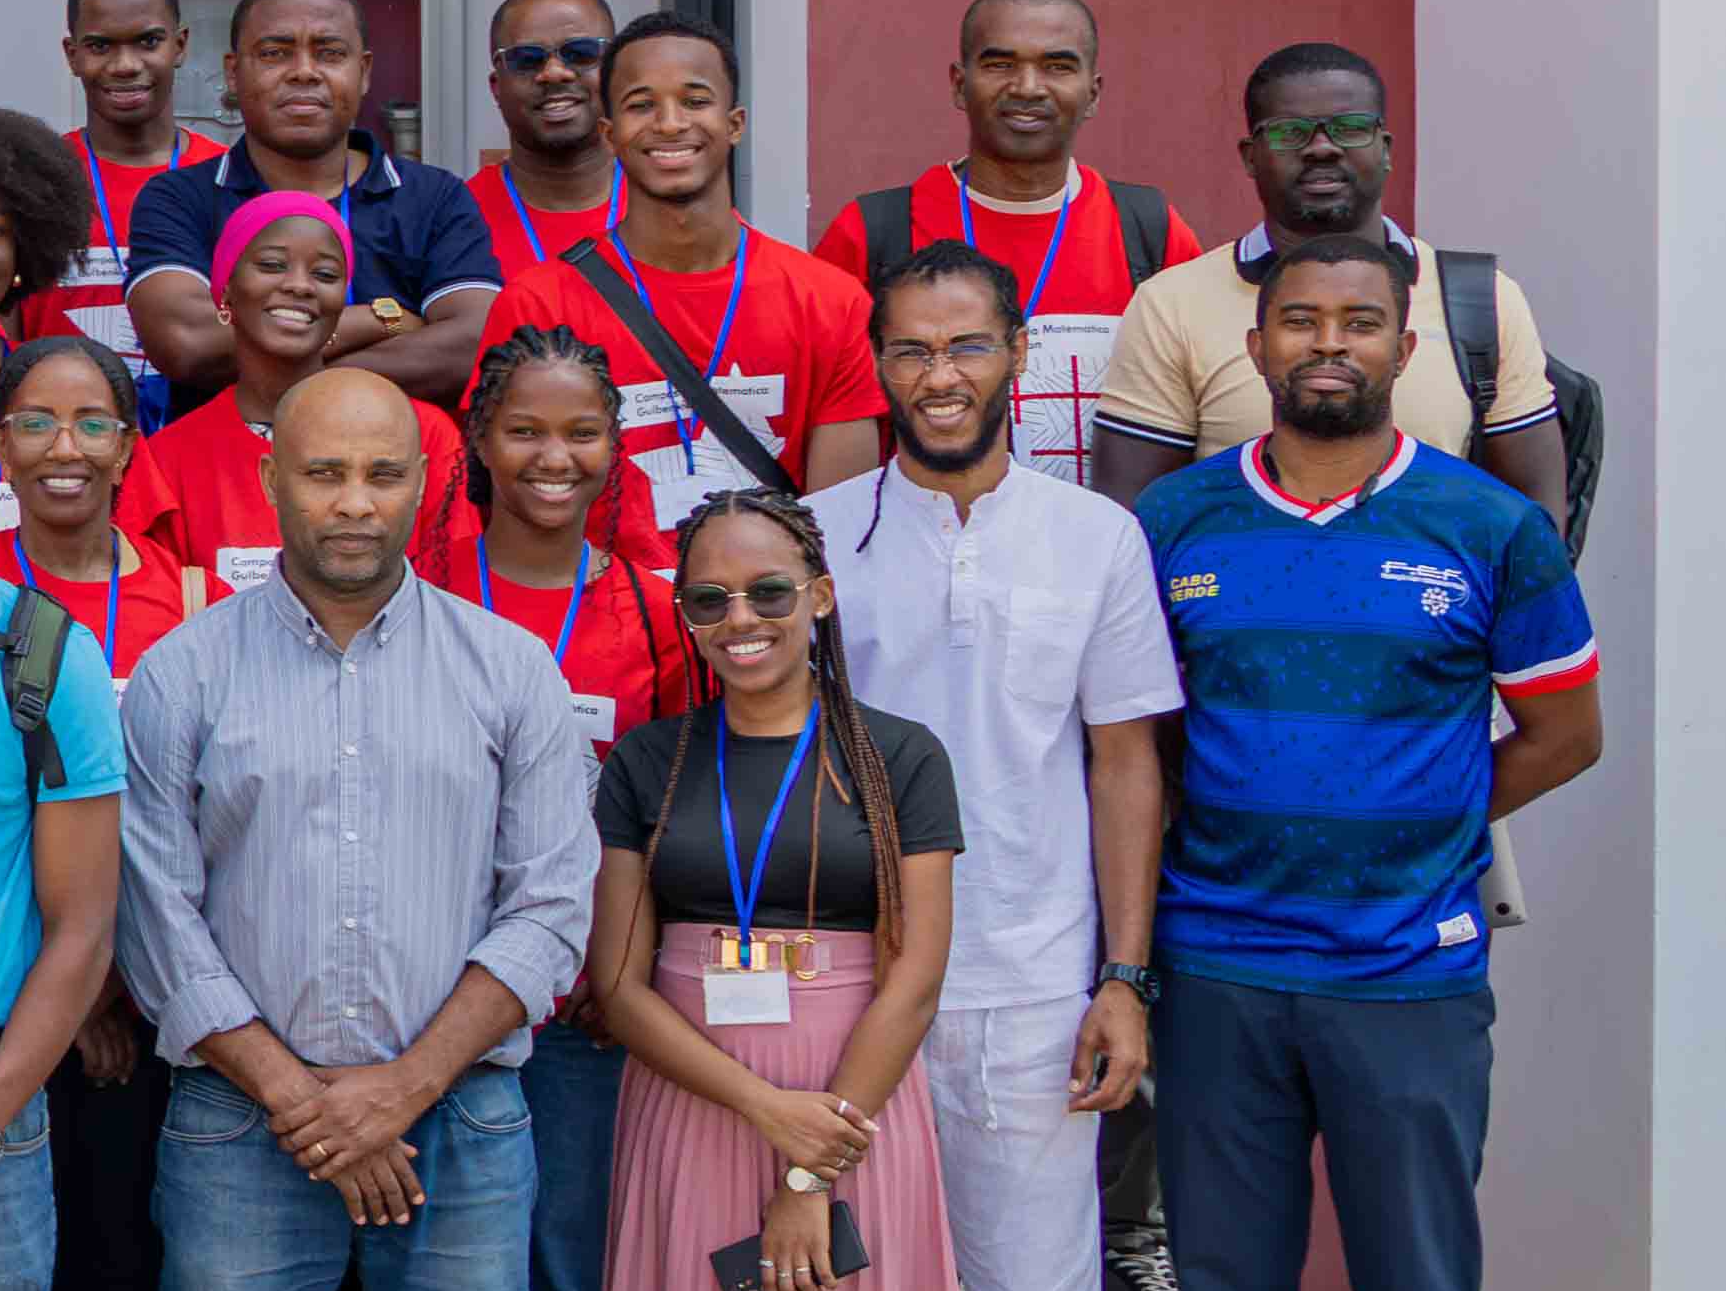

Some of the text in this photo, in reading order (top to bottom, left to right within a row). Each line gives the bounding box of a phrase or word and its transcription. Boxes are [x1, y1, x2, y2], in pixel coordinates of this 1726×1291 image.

[1043, 323, 1111, 335] Matemática
[231, 556, 276, 567] Campo
[1170, 572, 1217, 591] CABO
